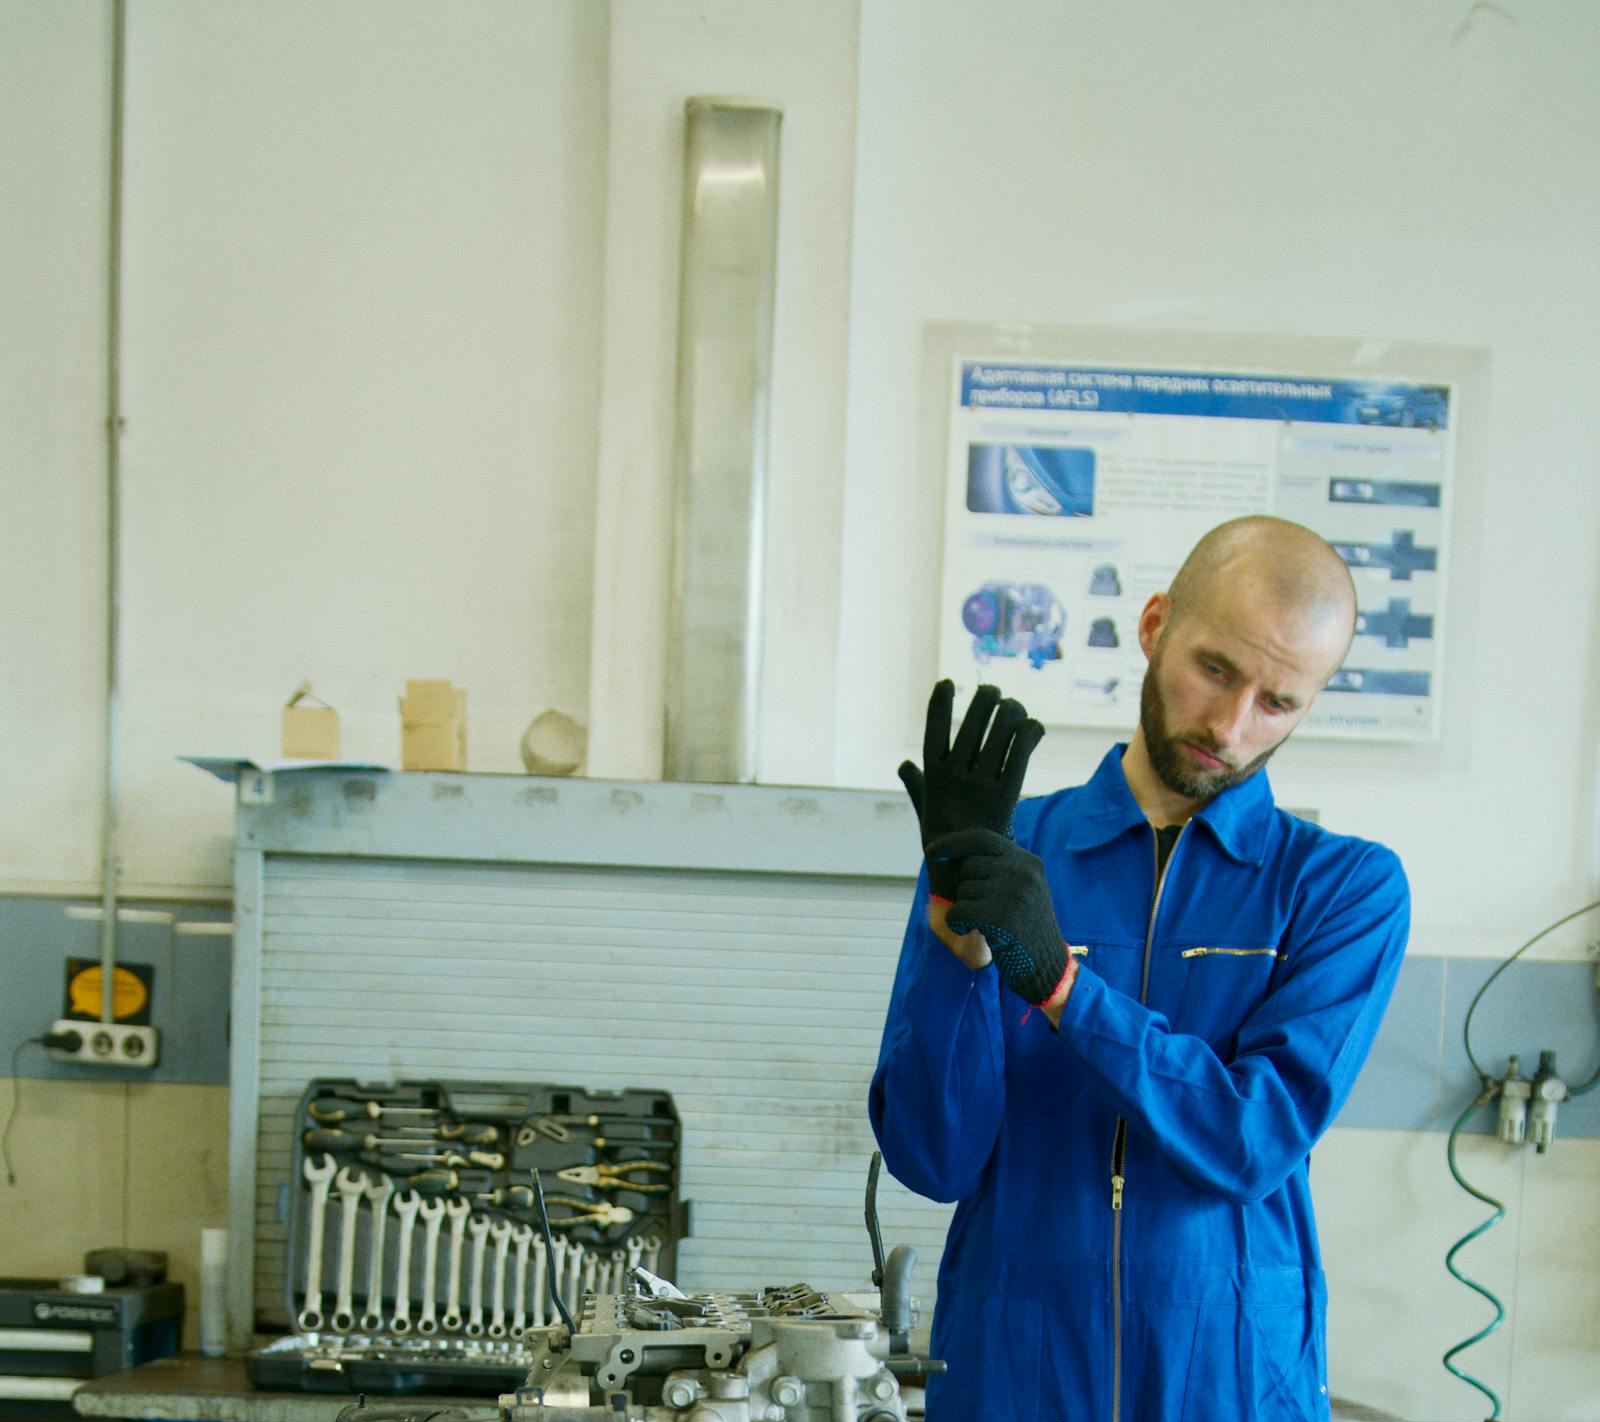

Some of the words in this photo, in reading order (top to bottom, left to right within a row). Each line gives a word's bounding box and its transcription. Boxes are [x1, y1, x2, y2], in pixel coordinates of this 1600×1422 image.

[971, 366, 1066, 386] Адаптивная
[1067, 372, 1133, 389] система
[1133, 375, 1210, 395] передних
[1211, 378, 1333, 399] осветительных
[970, 387, 1045, 406] приборов
[1047, 388, 1099, 409] (AFLS)
